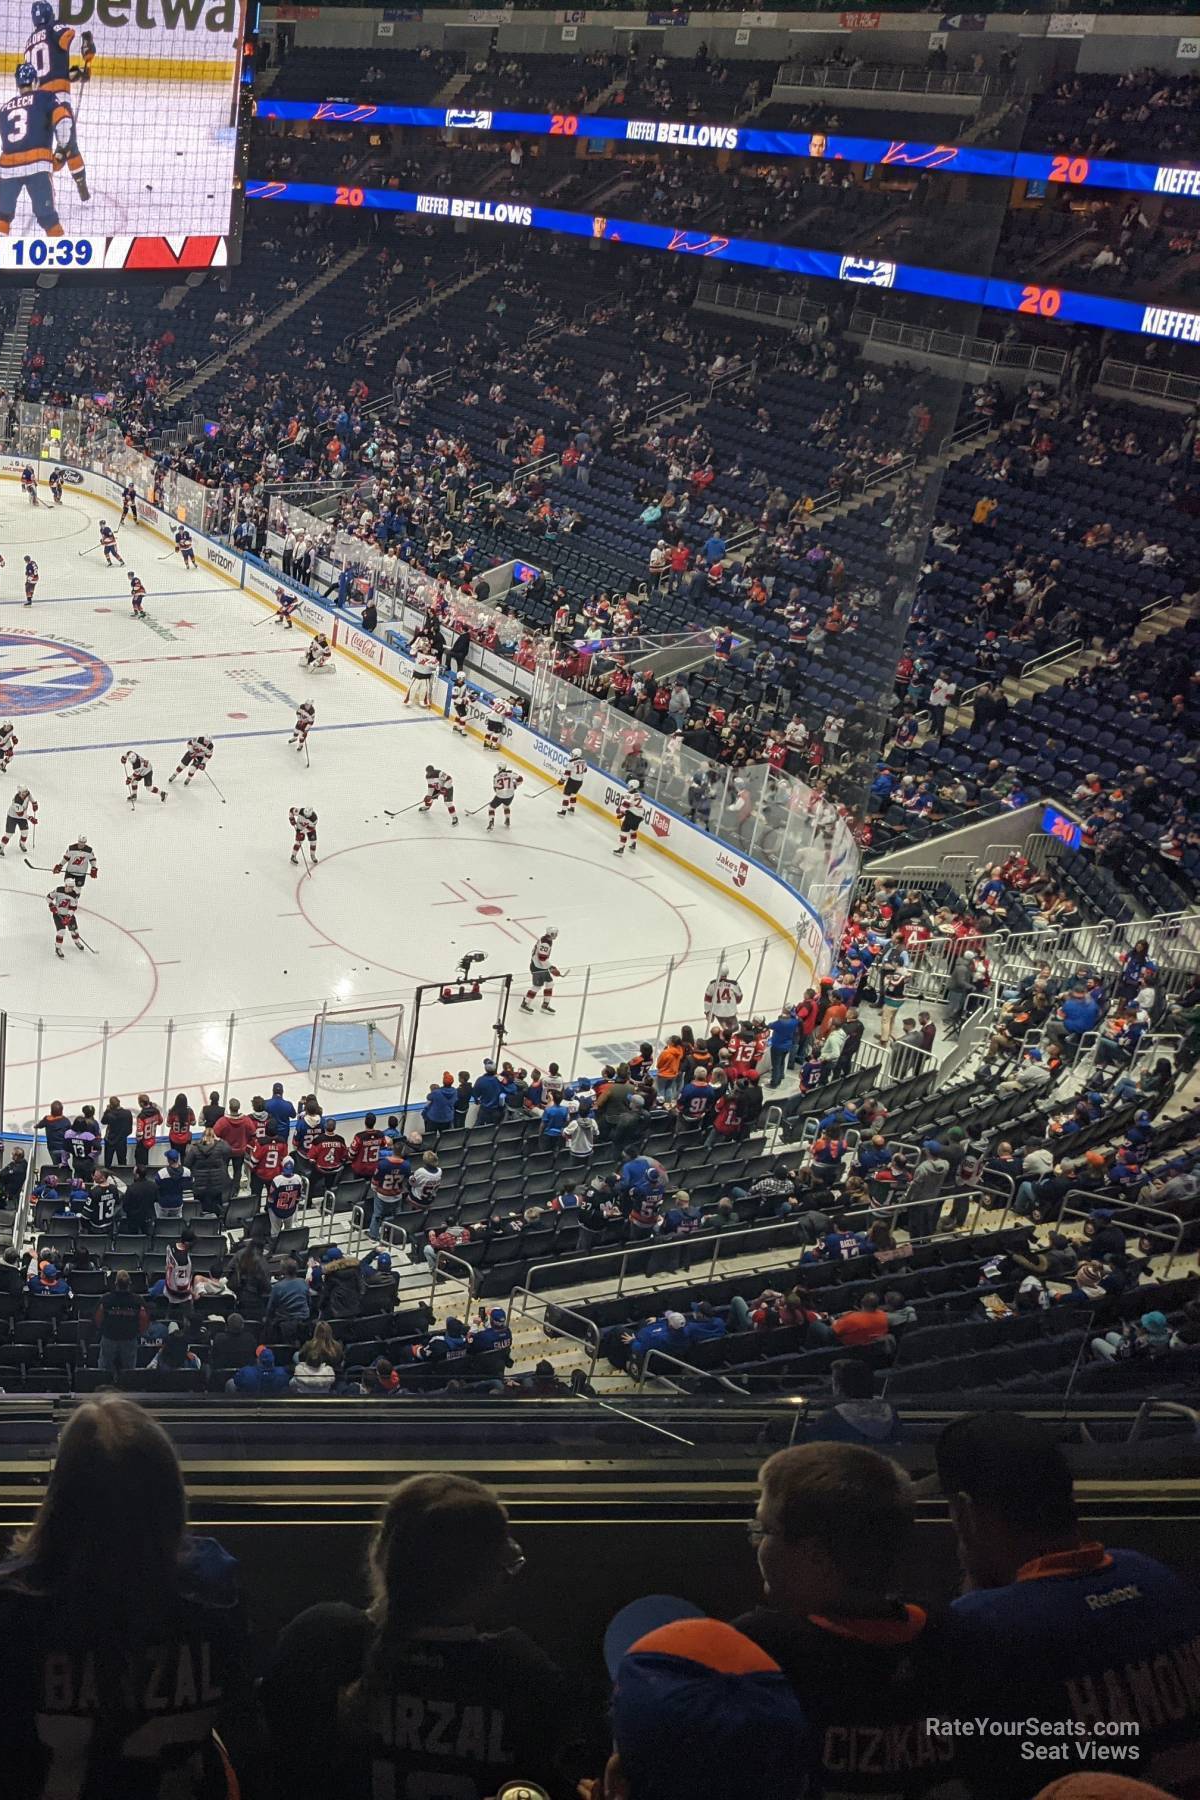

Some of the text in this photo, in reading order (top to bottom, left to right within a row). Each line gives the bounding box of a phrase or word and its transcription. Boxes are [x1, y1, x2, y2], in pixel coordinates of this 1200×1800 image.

[1181, 44, 1198, 54] 206
[1, 94, 34, 112] PELECH
[7, 107, 28, 143] 3
[550, 115, 739, 149] 20 KIEFFER BELLOWS
[1048, 155, 1090, 184] 20
[335, 187, 532, 226] 20 KIEFFER BELLOWS
[11, 239, 93, 266] 10:39
[1017, 285, 1061, 317] 20
[206, 548, 235, 572] verizon
[45, 631, 96, 650] Arena
[495, 777, 512, 790] 37
[653, 814, 670, 833] Rate
[715, 987, 732, 1004] 14
[735, 1045, 756, 1062] 13
[689, 1096, 708, 1112] 91
[72, 1143, 86, 1159] 13
[321, 1140, 342, 1149] STEVENS
[265, 1150, 279, 1169] 9
[323, 1147, 335, 1164] 4
[362, 1145, 381, 1164] 13
[285, 1184, 294, 1192] LEE
[98, 1199, 117, 1221] 13
[275, 1191, 300, 1210] 27
